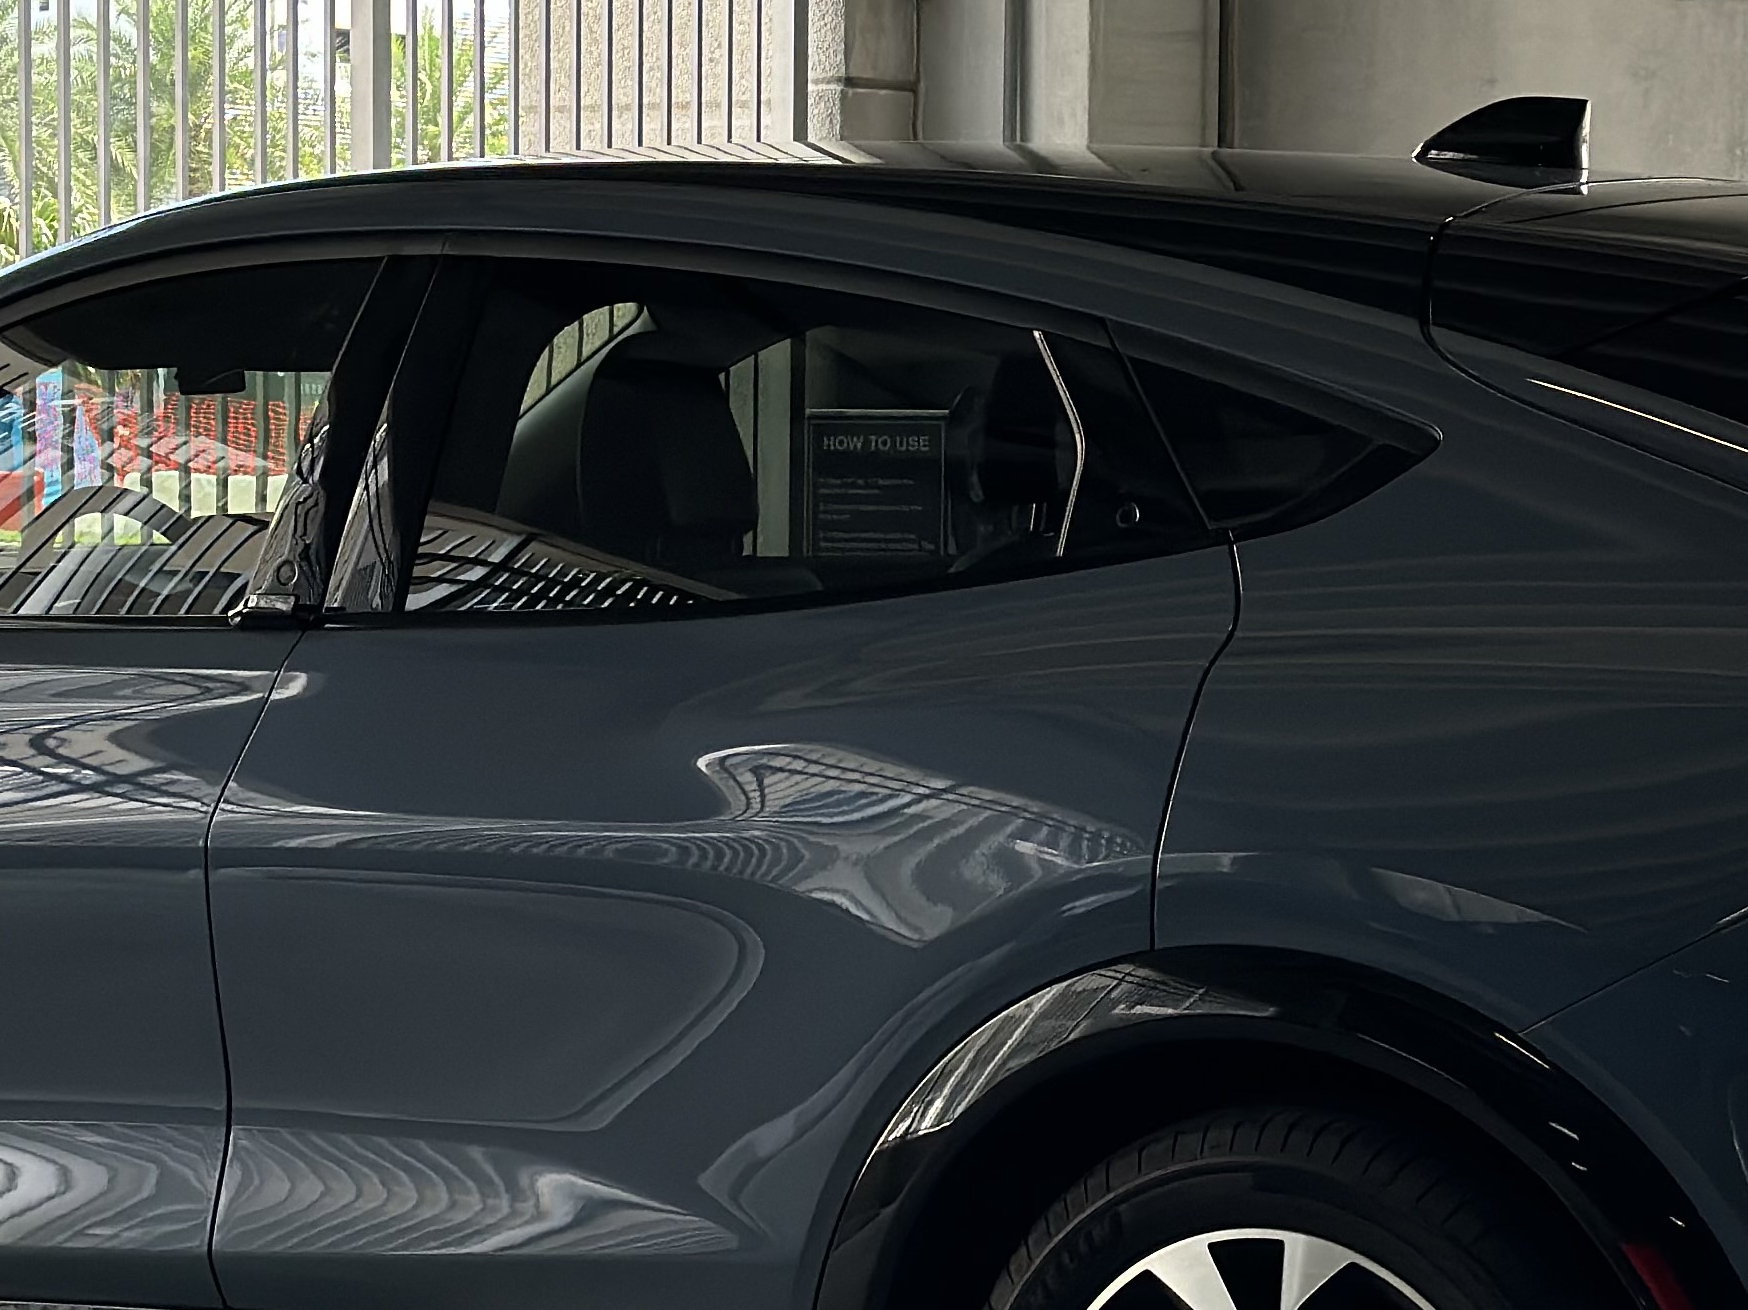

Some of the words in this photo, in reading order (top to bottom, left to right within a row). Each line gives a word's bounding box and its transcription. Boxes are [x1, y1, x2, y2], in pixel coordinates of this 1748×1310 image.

[823, 435, 864, 451] HOW
[869, 435, 891, 451] TO
[896, 436, 929, 451] USE
